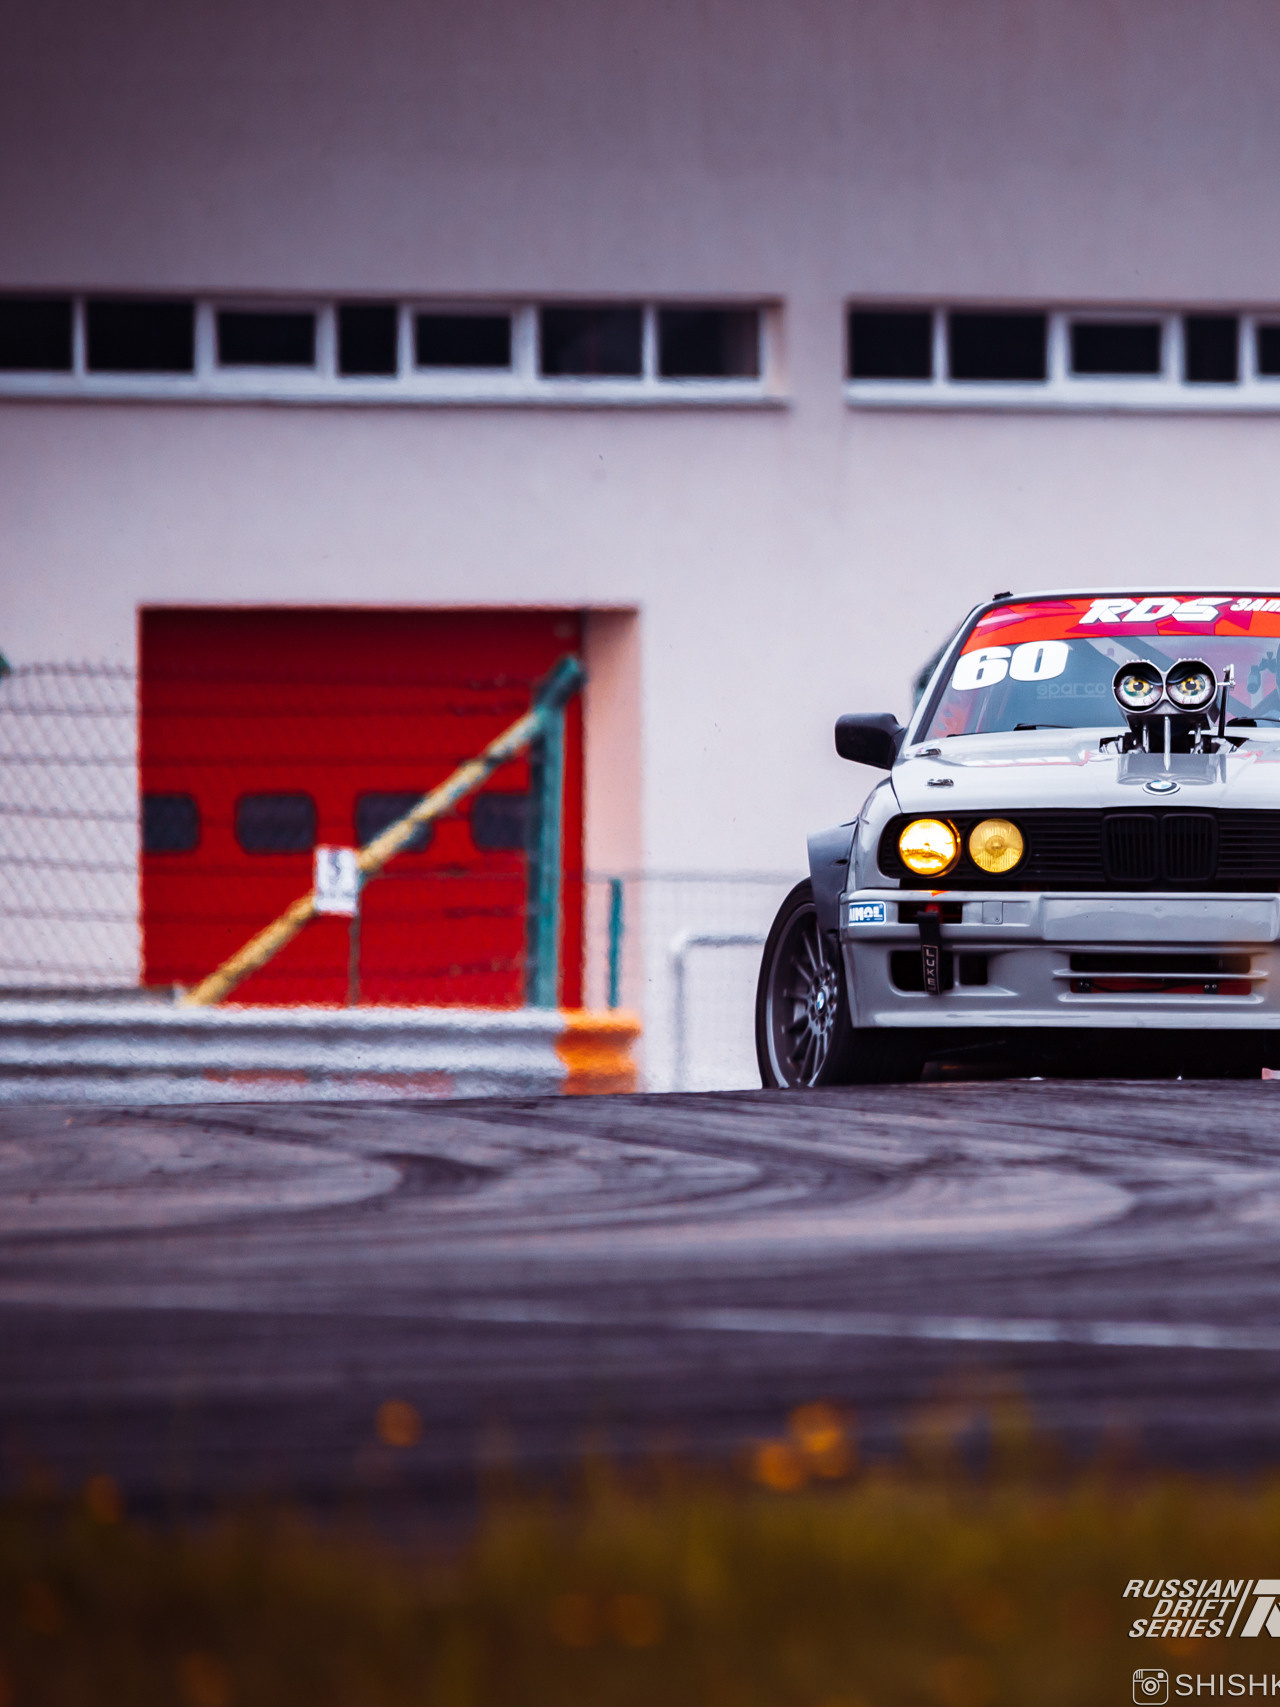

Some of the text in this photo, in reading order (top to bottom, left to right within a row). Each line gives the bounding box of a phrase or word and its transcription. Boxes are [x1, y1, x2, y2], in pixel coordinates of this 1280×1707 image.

[1079, 598, 1233, 624] RDS
[951, 640, 1069, 691] 60
[1036, 682, 1106, 699] sparco
